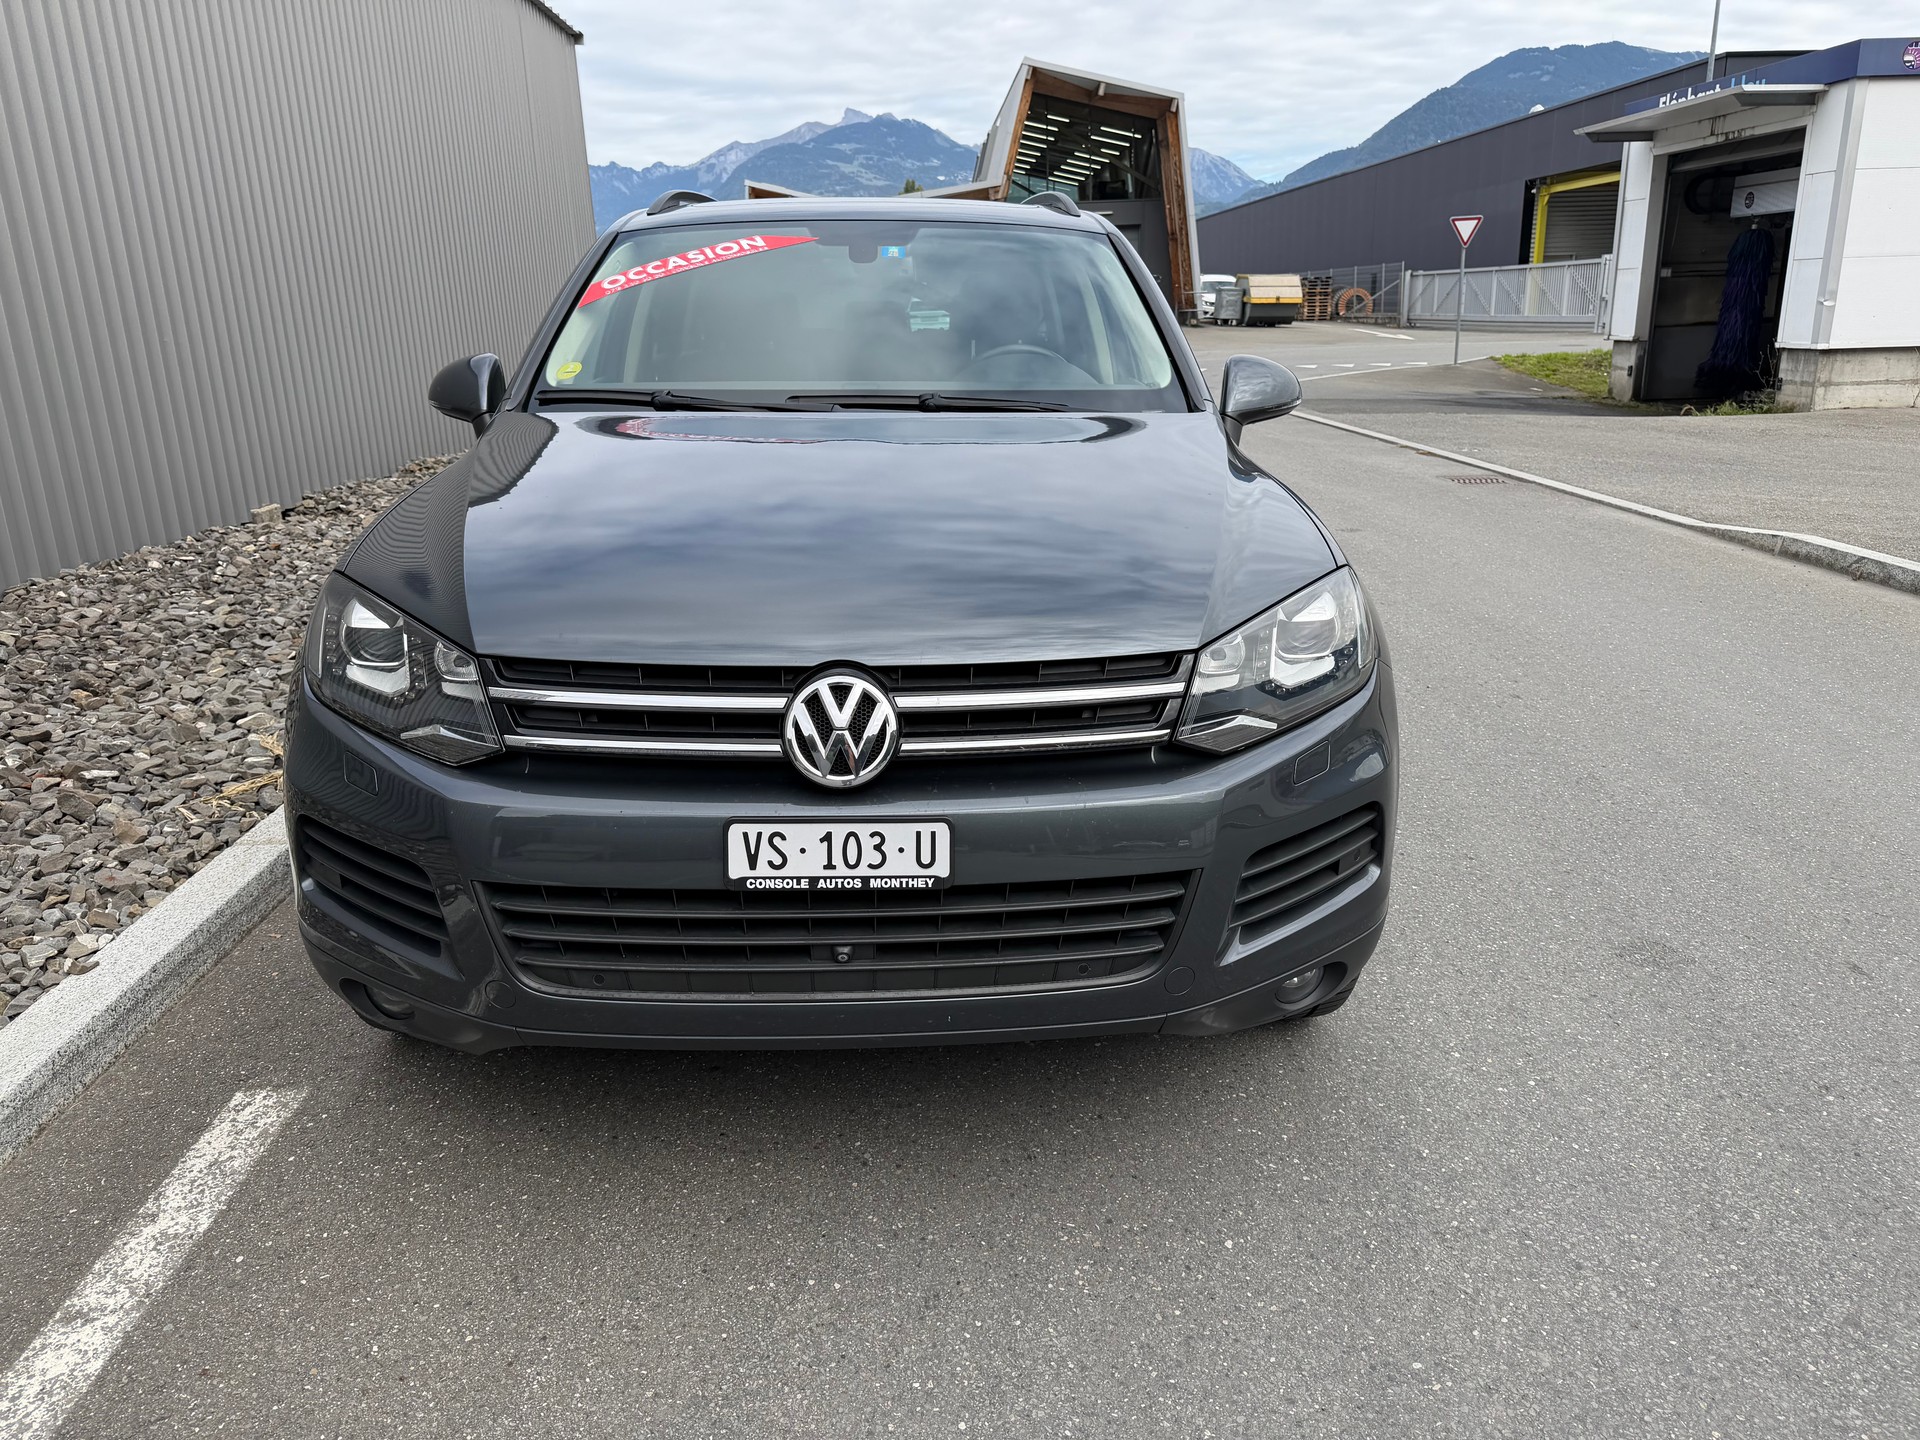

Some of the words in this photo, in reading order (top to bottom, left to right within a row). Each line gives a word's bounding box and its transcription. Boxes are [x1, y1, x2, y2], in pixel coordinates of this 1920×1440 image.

[600, 235, 767, 290] OCCASION
[746, 878, 810, 889] CONSOLE
[817, 878, 862, 889] AUTOS
[870, 878, 935, 889] MONTHEY
